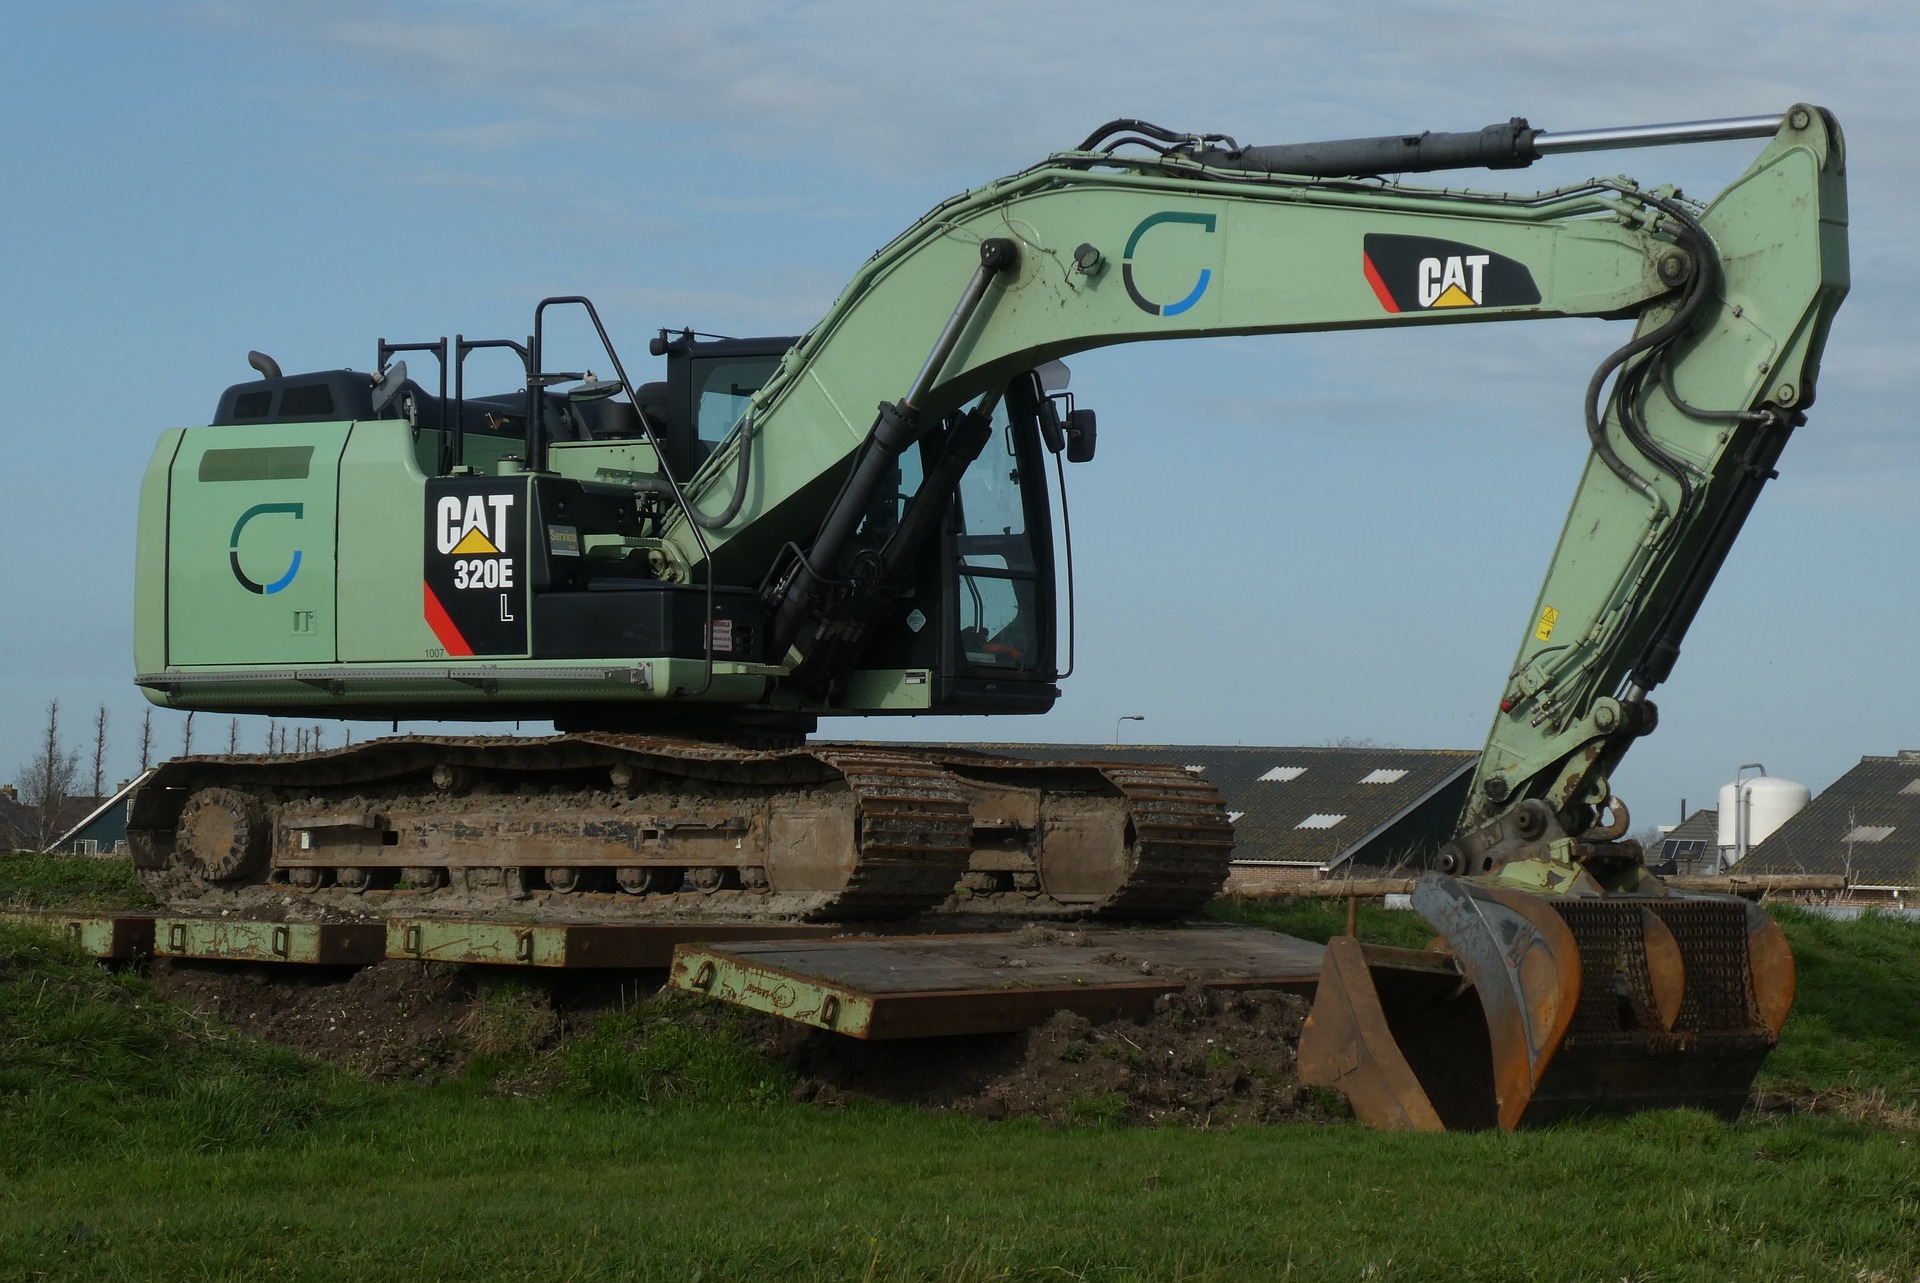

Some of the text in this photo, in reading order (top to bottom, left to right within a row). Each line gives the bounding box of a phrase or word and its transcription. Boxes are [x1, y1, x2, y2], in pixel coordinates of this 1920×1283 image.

[1419, 254, 1489, 308] CAT
[437, 494, 514, 555] CAT
[550, 528, 577, 542] Service
[454, 558, 513, 590] 320E
[500, 593, 514, 622] L
[424, 648, 445, 658] 1007
